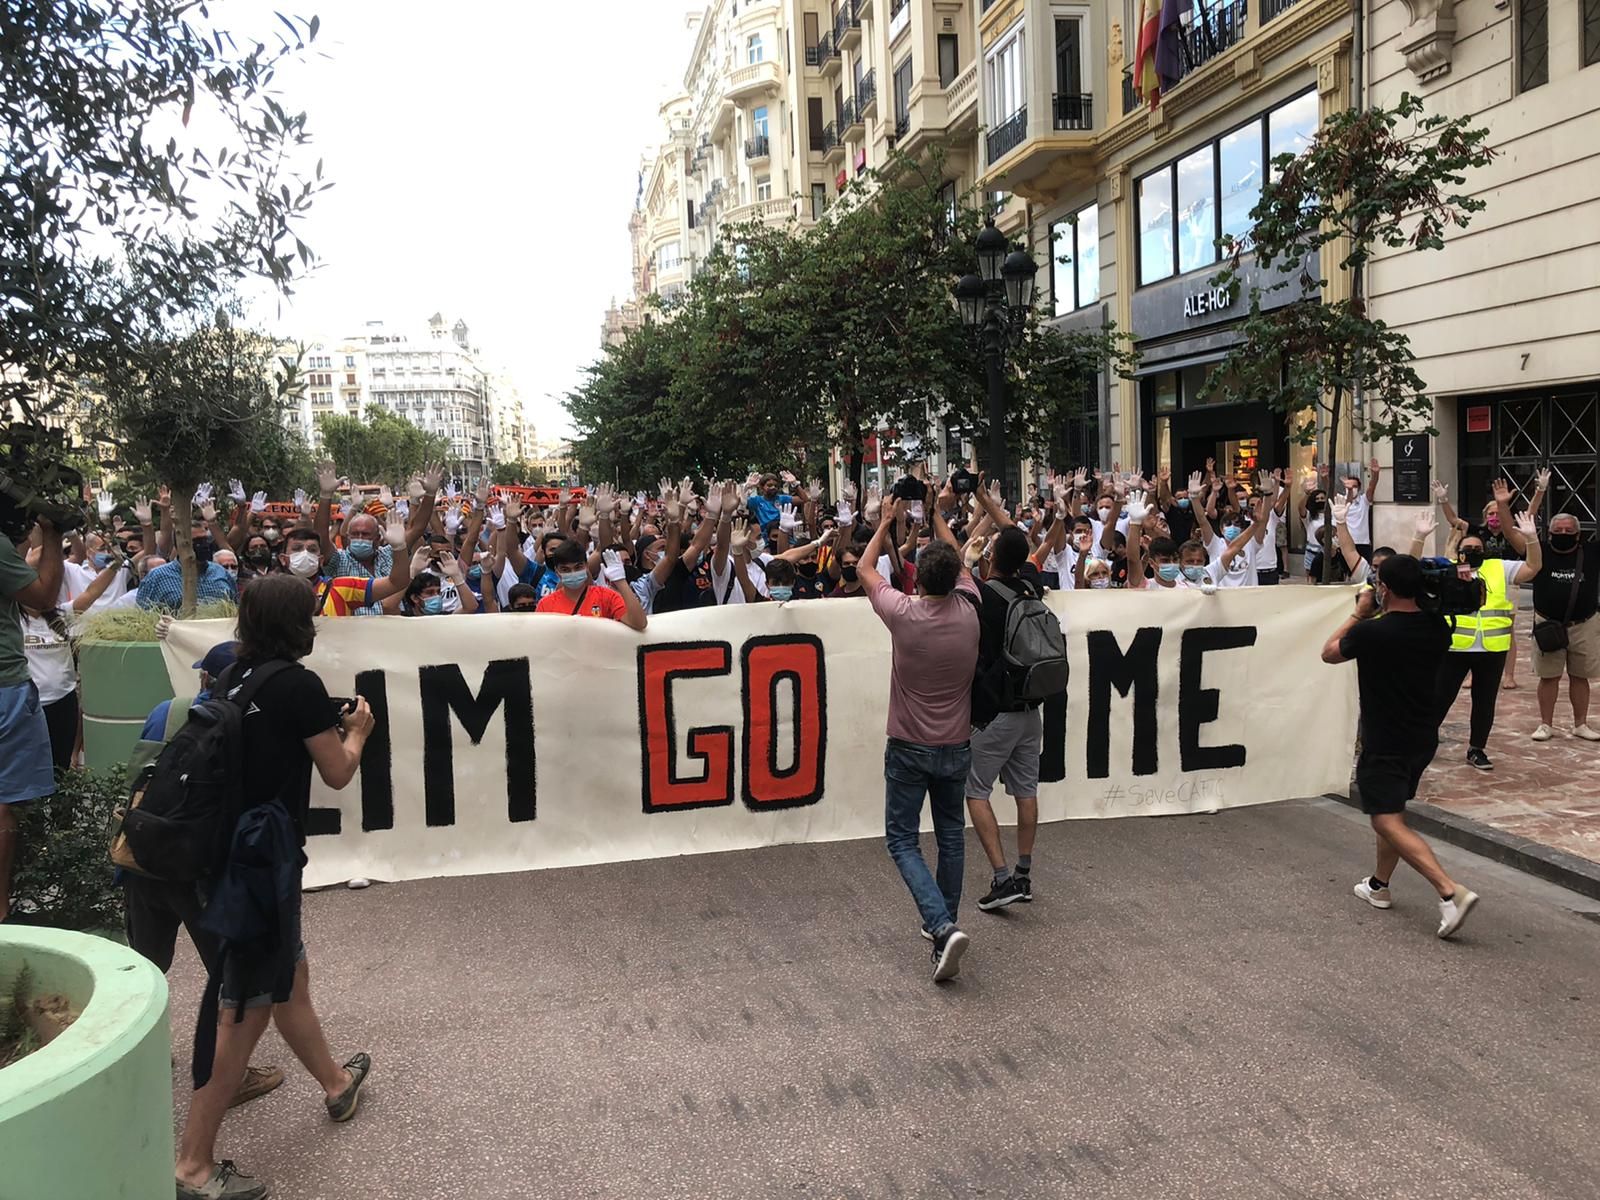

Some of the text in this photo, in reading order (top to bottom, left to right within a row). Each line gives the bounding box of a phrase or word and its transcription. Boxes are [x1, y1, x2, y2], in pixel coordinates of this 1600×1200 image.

[1520, 352, 1531, 371] 7
[307, 657, 536, 836] IM
[637, 633, 828, 814] GO
